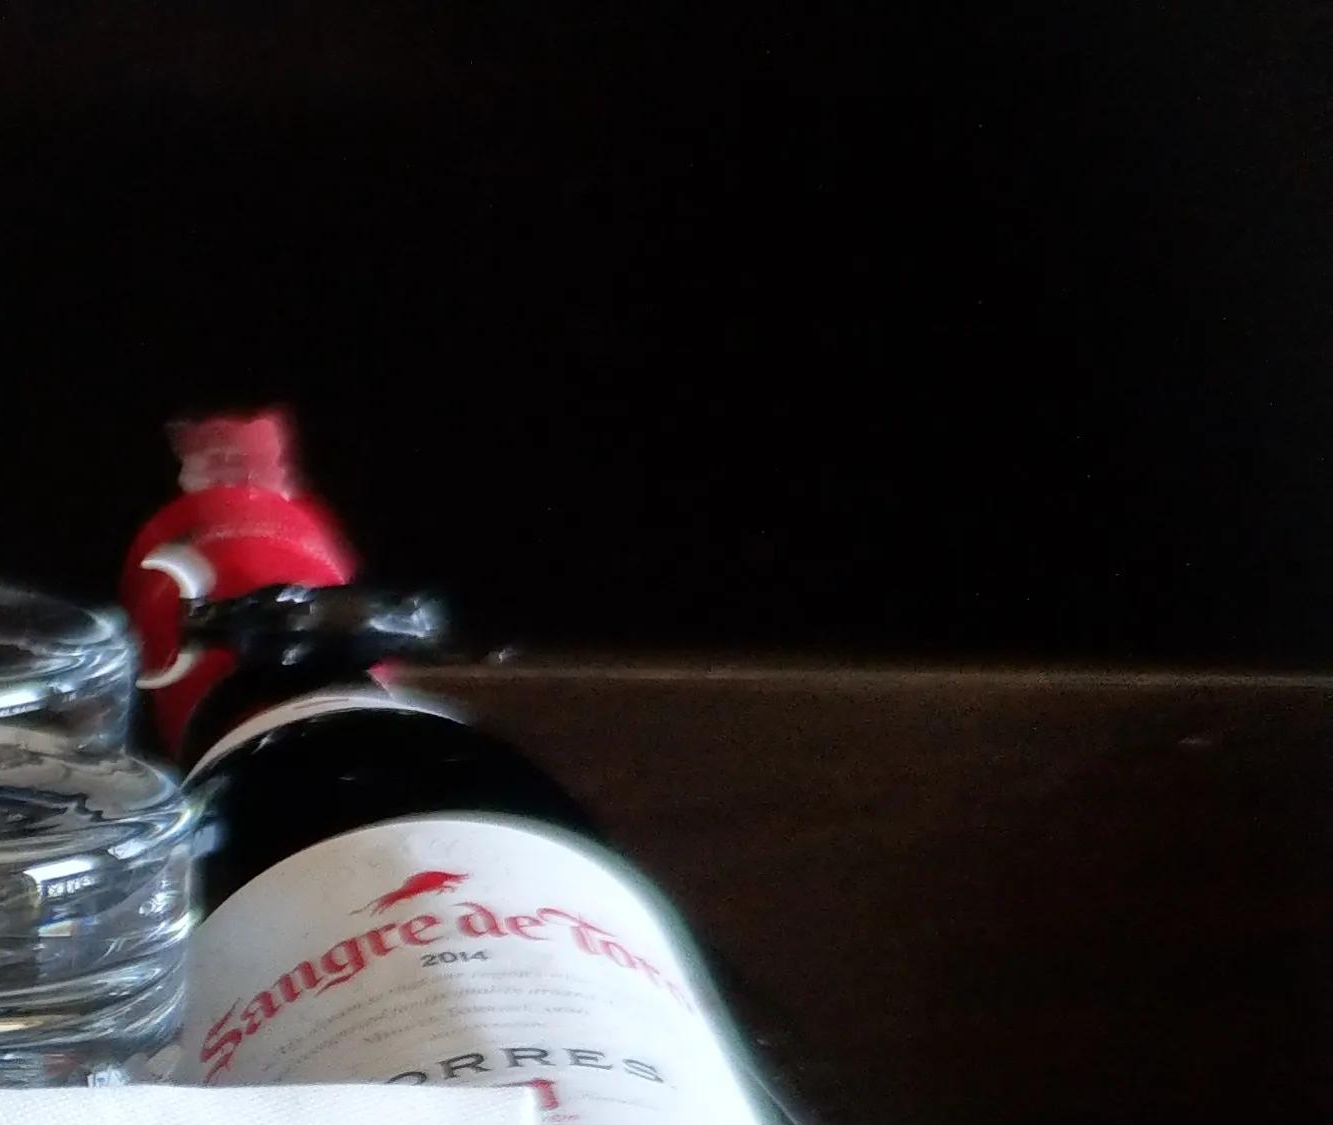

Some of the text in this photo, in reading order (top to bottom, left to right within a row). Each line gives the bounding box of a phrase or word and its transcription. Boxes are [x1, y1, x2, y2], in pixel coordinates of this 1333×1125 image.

[200, 912, 445, 1083] Sangre
[453, 901, 551, 941] de
[420, 951, 489, 968] 2014
